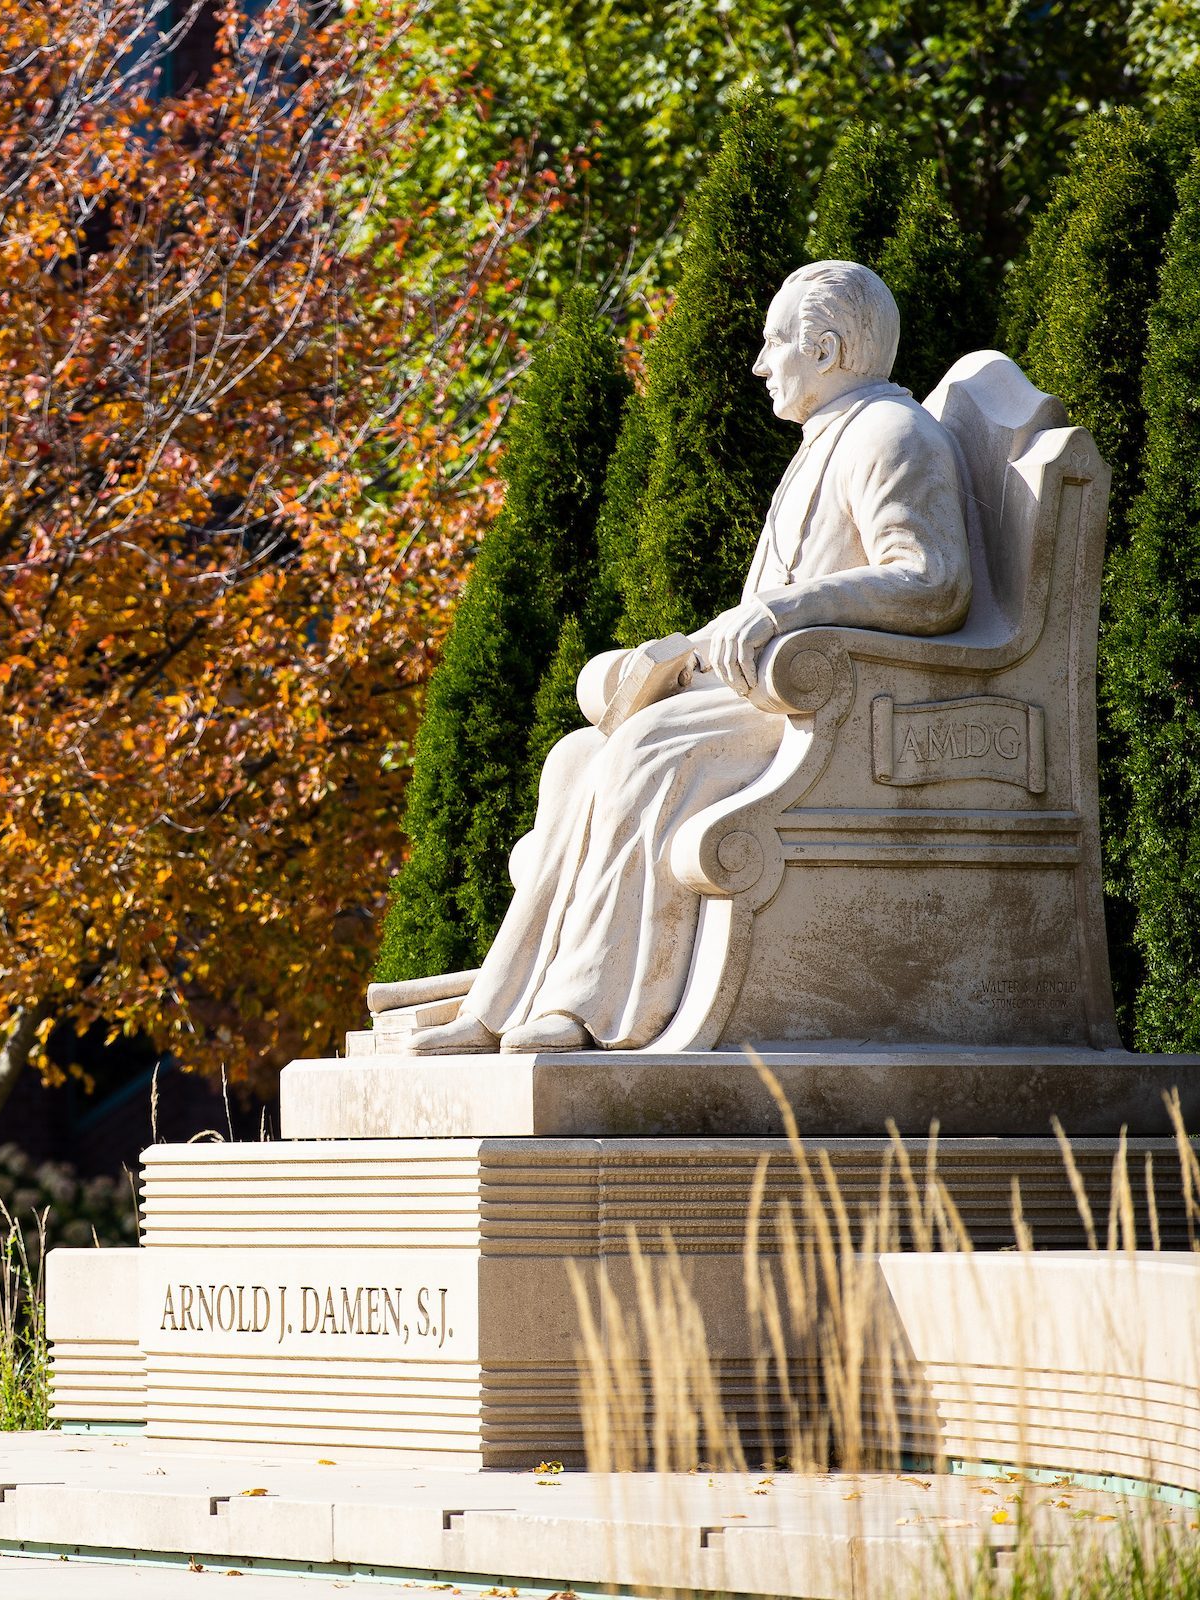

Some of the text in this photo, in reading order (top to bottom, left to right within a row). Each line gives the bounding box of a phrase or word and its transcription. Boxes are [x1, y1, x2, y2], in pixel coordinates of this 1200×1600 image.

[897, 721, 1022, 763] AMDG
[981, 980, 1019, 993] WALTER
[1035, 981, 1077, 993] ARNOLD
[160, 1284, 454, 1349] ARNOLD J. DAMEN, S.J.
